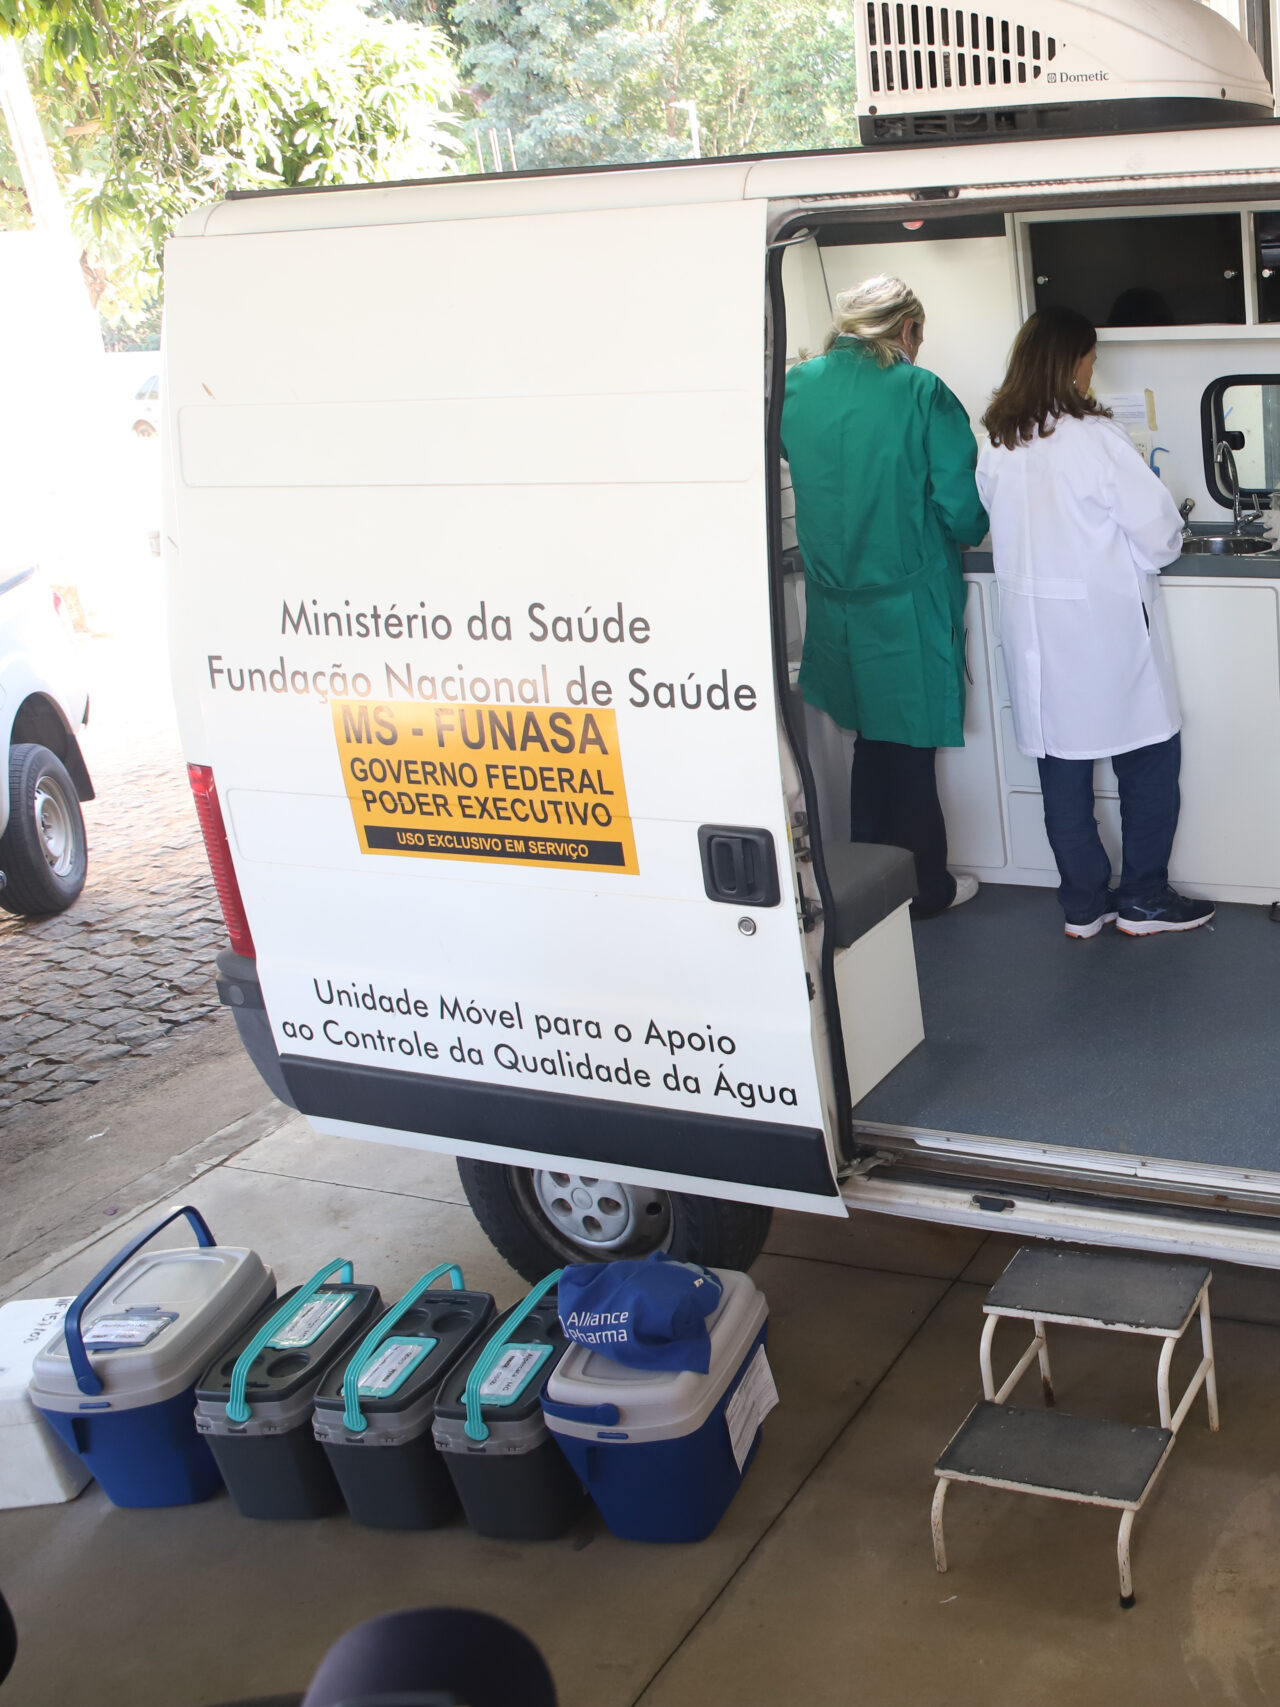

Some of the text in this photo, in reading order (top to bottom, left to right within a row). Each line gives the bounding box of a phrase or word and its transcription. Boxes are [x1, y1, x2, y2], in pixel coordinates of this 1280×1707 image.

[1060, 70, 1109, 82] Dometic
[281, 599, 651, 644] Ministério da Saúde
[207, 655, 757, 711] Fundação Nacional de Saúde
[342, 704, 398, 747] MS
[435, 708, 609, 756] FUNASA
[350, 757, 614, 795] GOVERNO FEDERAL
[362, 790, 612, 828] PODER EXECUTIVO
[396, 832, 589, 860] USO EXCLUSIVO EM SERVIÇO
[313, 978, 736, 1055] Unidade Móvel para o Apoio
[282, 1020, 798, 1109] ao Controle da Qualidade da Água
[566, 1311, 629, 1327] Alliance
